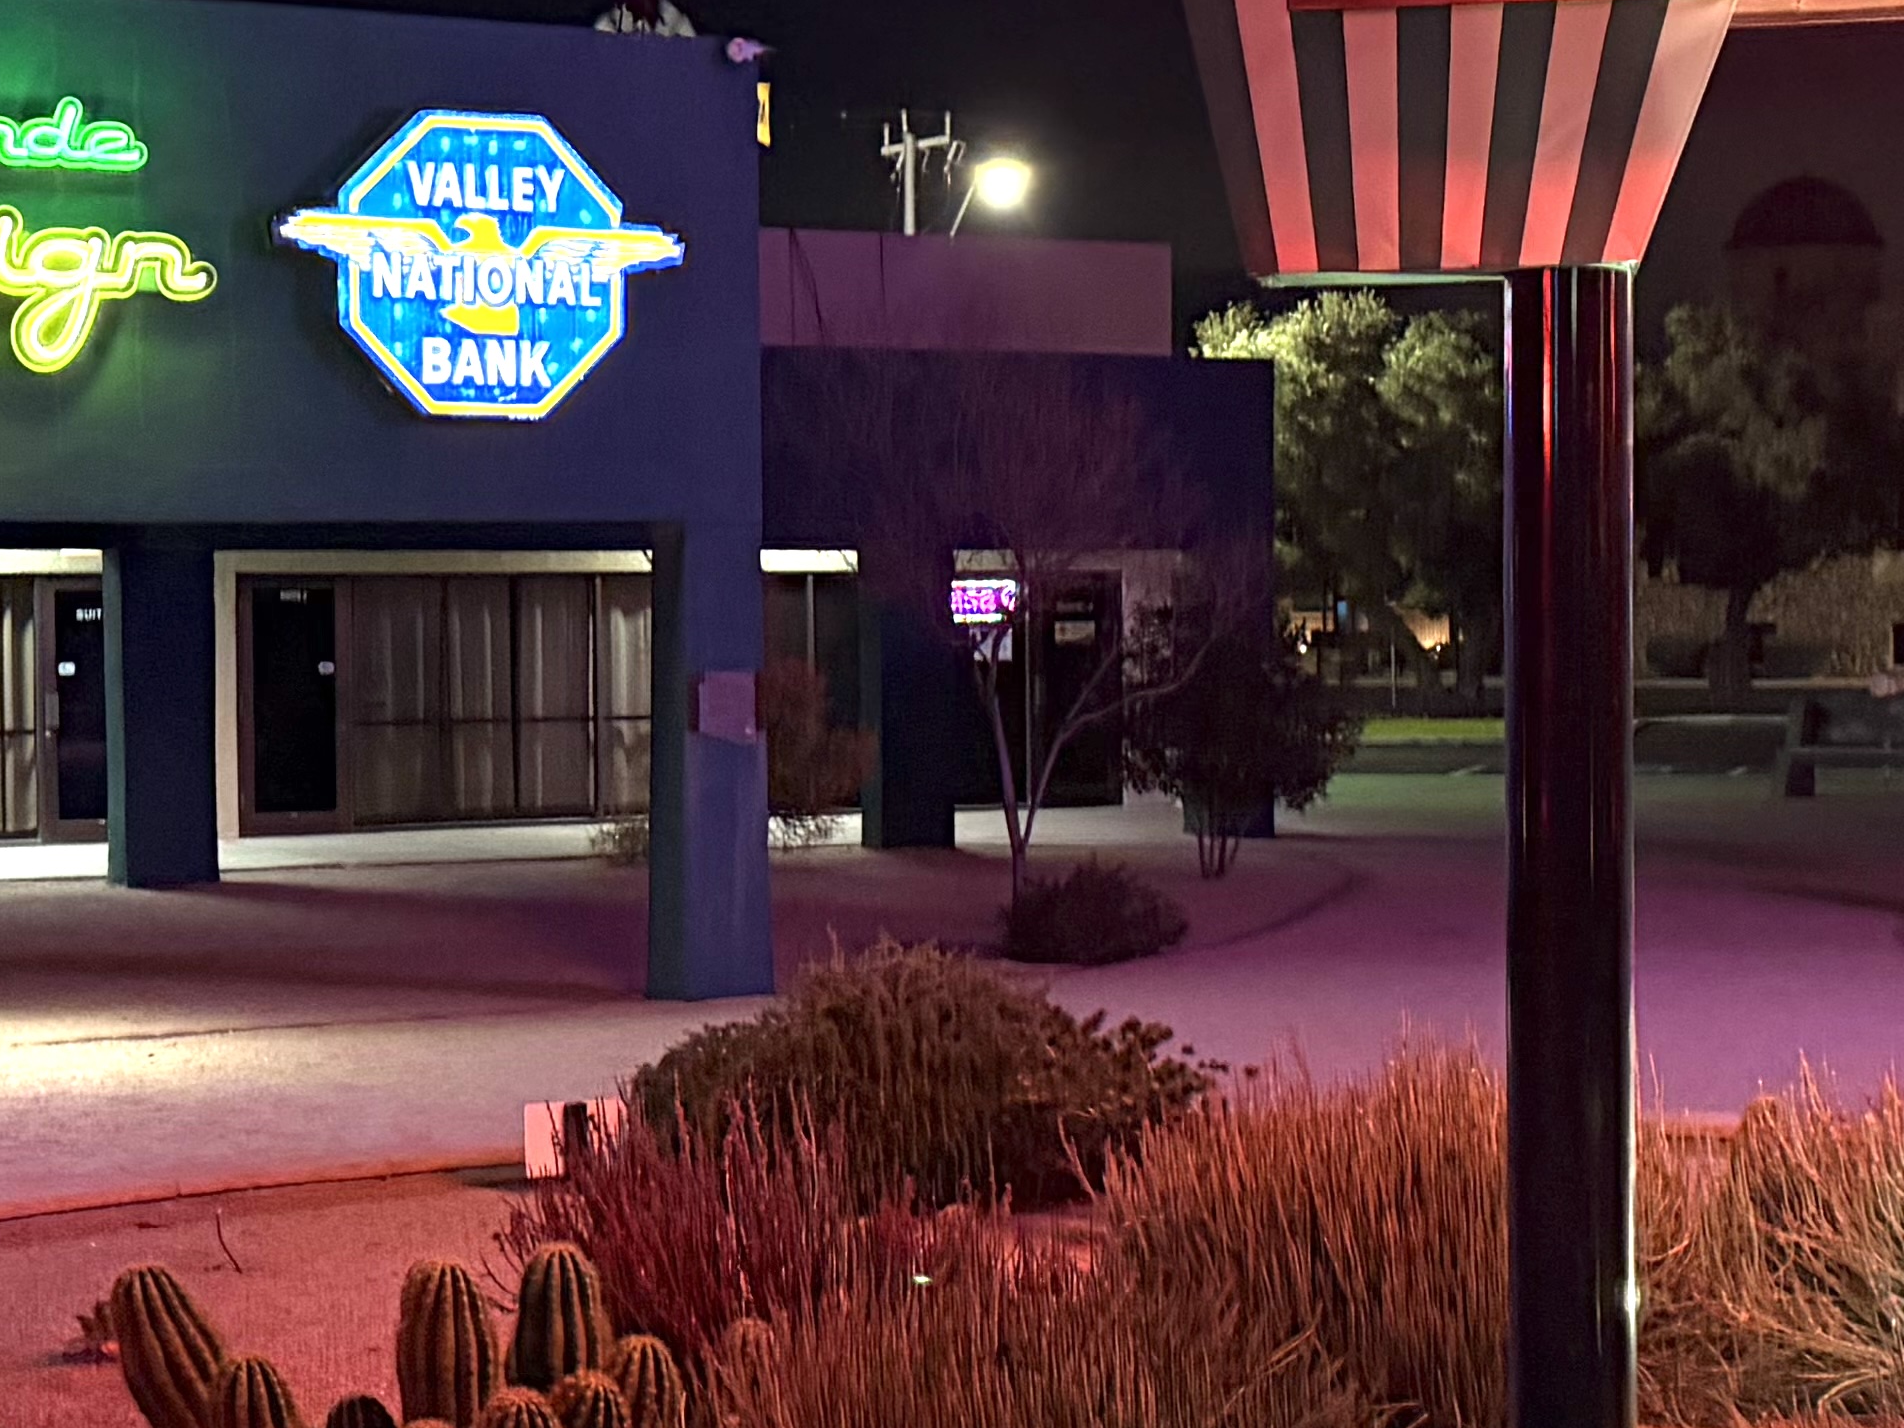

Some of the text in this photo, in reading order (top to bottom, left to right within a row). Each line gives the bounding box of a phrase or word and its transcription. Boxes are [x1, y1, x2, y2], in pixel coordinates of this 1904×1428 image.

[405, 159, 566, 213] VALLEY
[371, 250, 602, 307] NATIONAL
[420, 335, 553, 388] BANK
